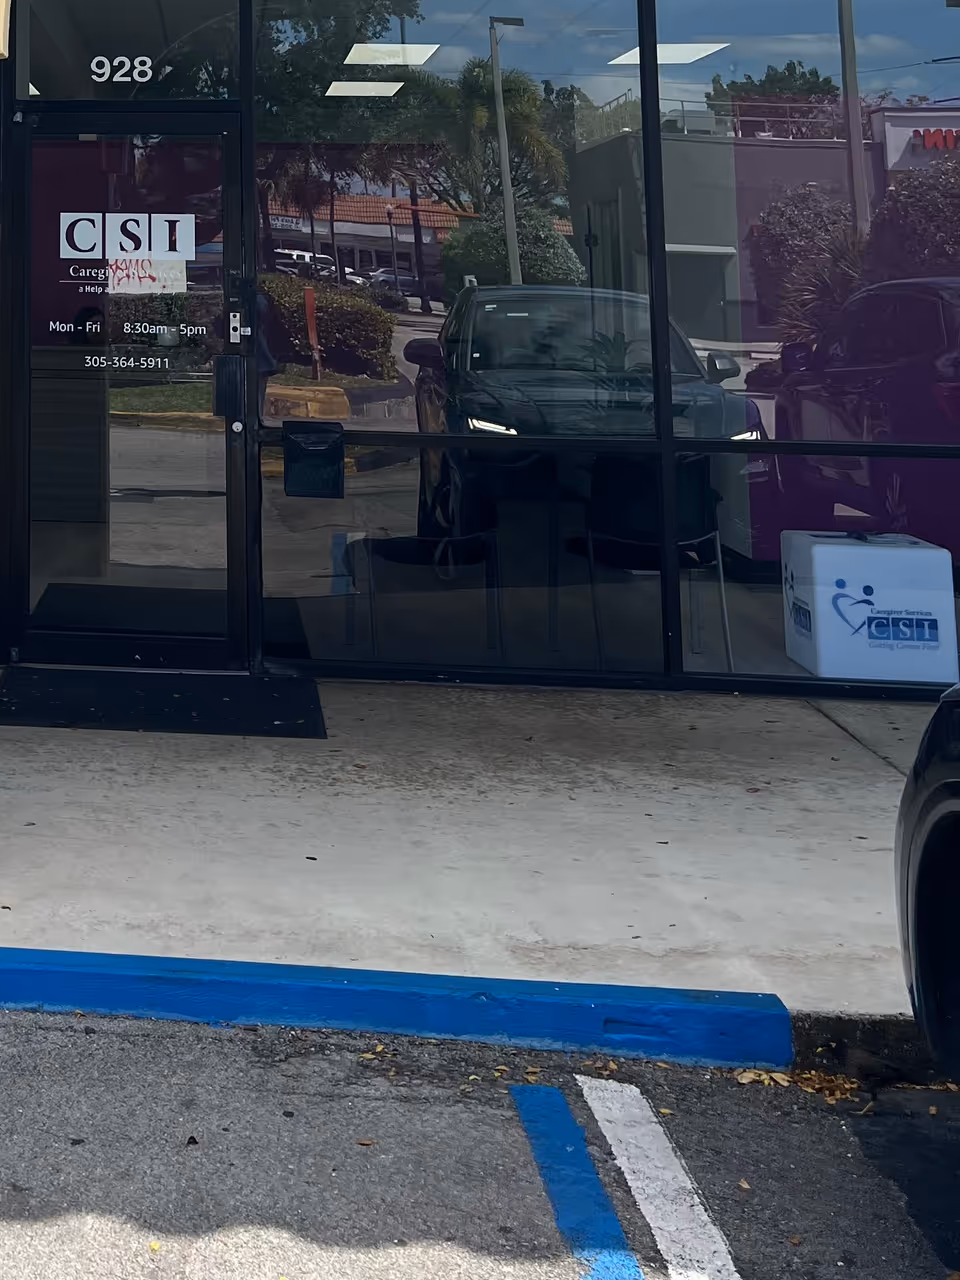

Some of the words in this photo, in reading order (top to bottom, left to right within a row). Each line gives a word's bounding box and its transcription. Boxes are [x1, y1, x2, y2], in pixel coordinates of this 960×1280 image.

[90, 55, 153, 83] 928
[65, 217, 181, 254] CSI
[85, 285, 103, 294] Help
[49, 321, 74, 333] Mon
[86, 321, 101, 333] Fri
[123, 322, 167, 334] 8:30am
[179, 323, 207, 337] 5pm
[84, 355, 170, 369] 305-364-5911
[870, 618, 932, 640] CSI
